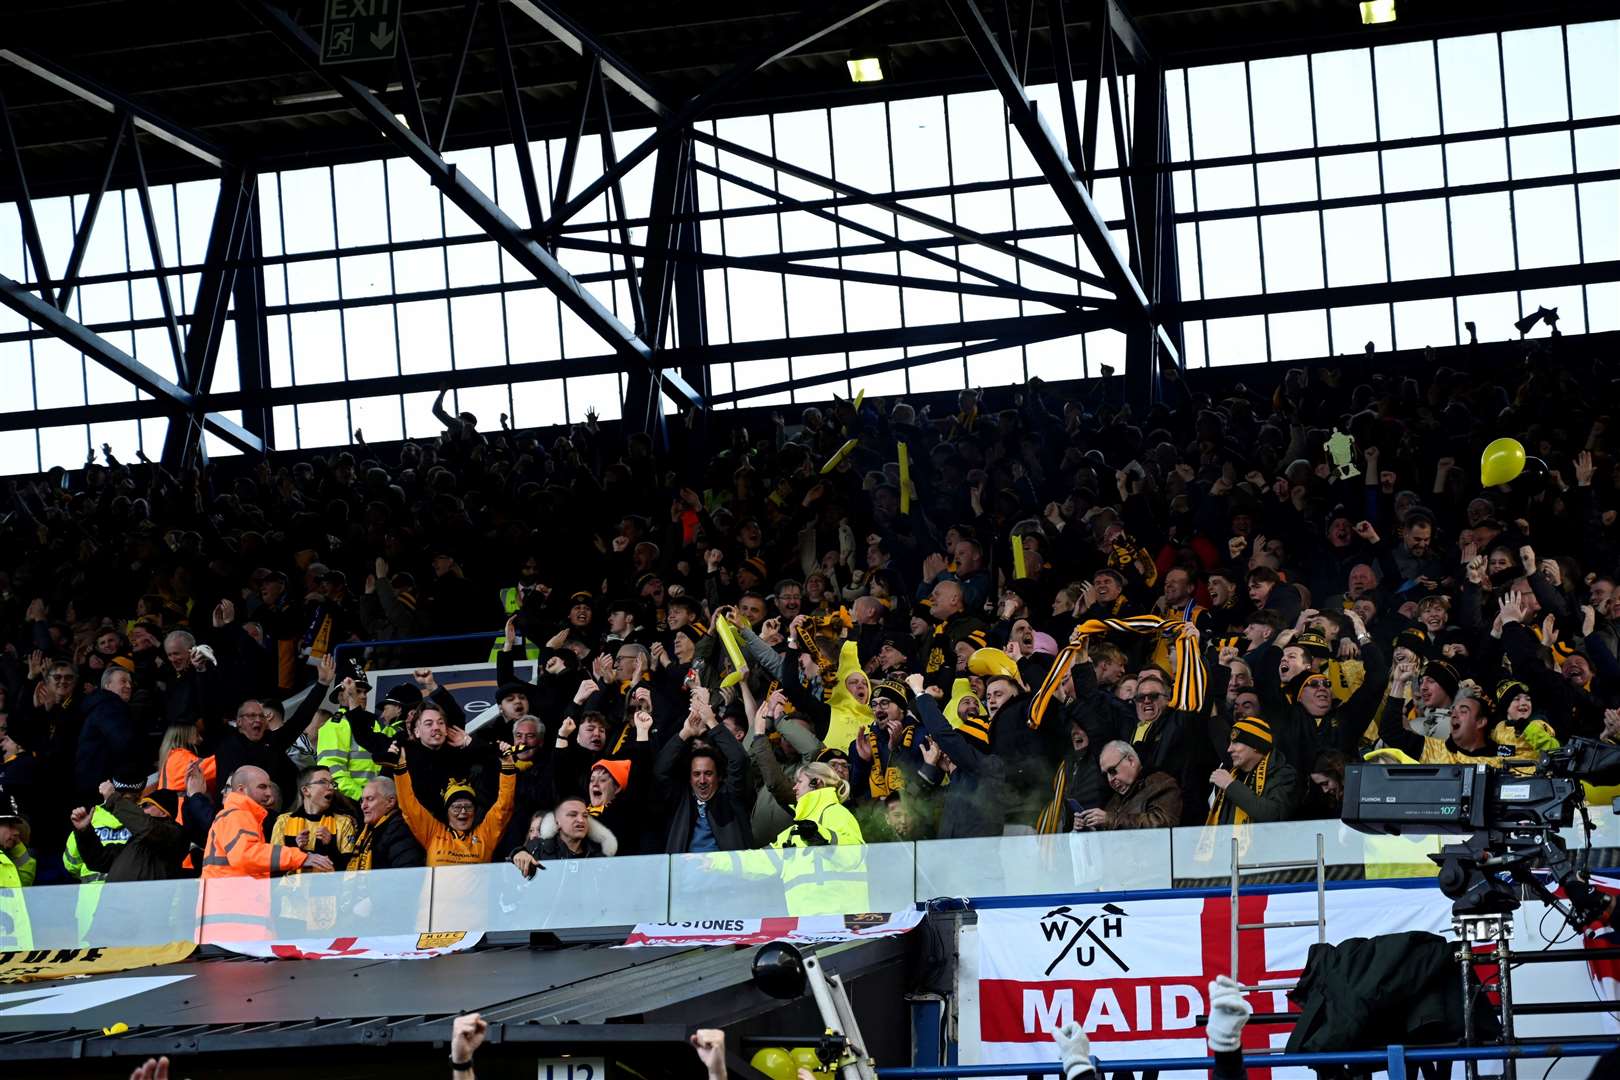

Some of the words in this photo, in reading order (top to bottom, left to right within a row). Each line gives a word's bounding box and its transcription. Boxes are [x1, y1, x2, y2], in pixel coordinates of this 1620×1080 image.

[1440, 806, 1456, 815] 107
[1040, 921, 1068, 942] W
[1103, 918, 1122, 938] H
[1076, 946, 1095, 967] U
